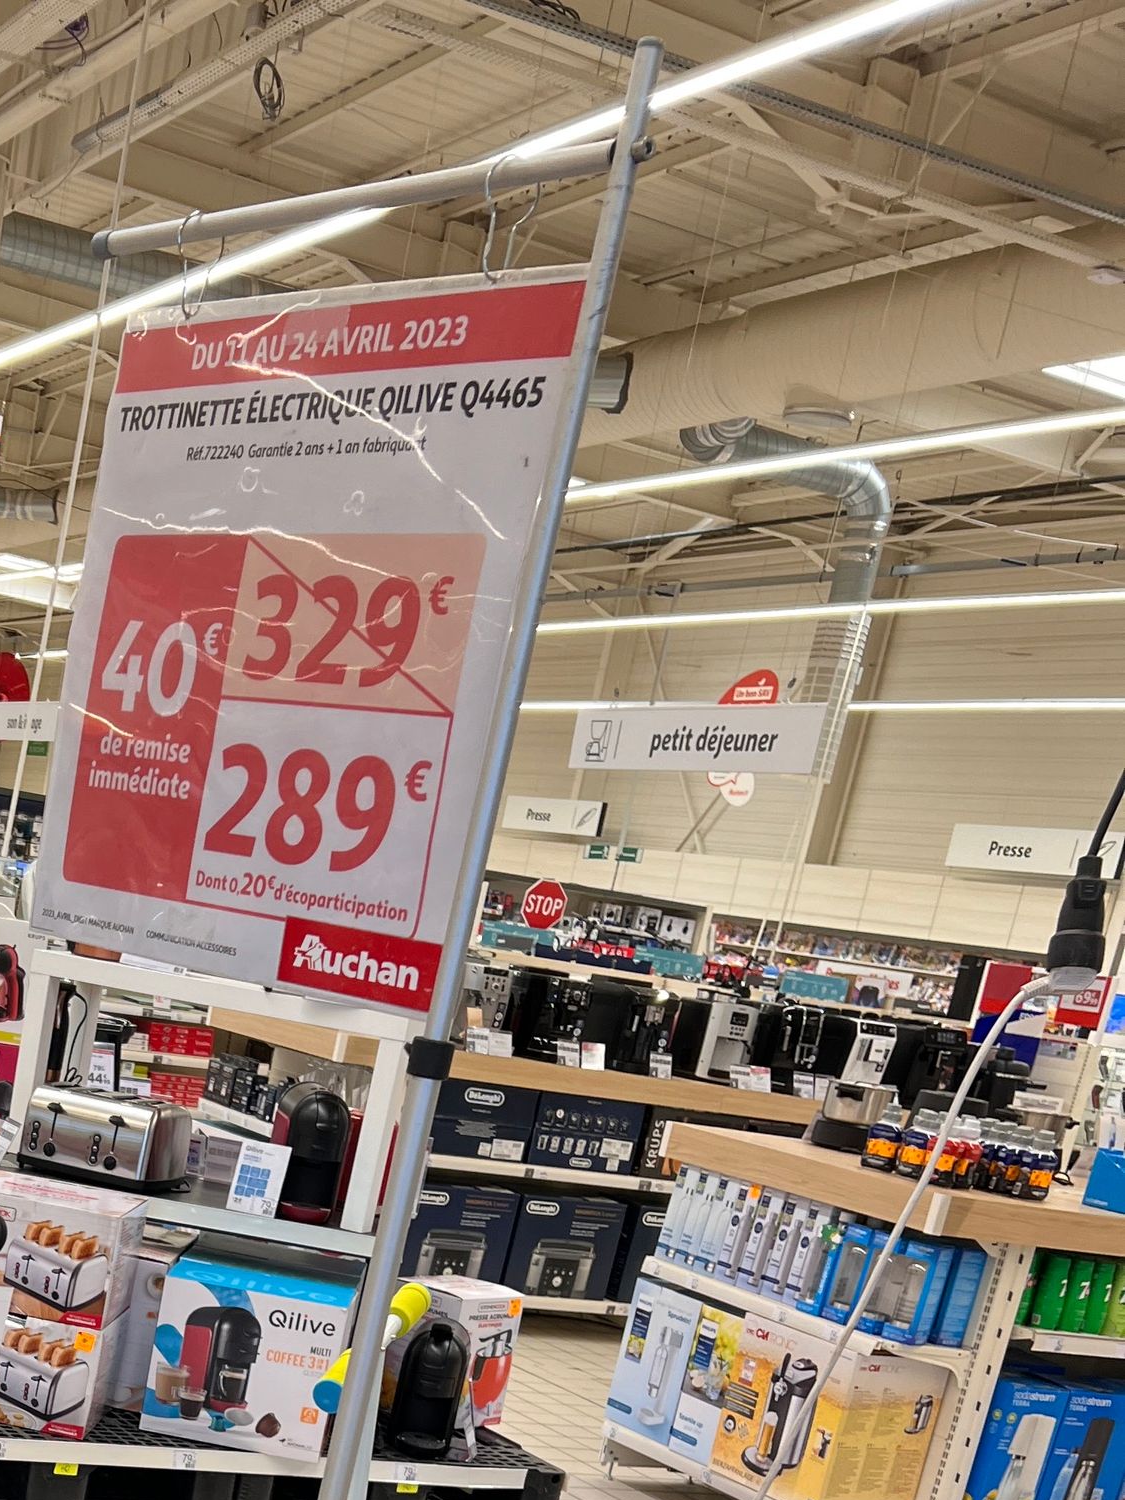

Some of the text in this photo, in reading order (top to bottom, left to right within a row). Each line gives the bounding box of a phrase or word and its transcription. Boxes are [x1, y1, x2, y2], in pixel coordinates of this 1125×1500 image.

[192, 342, 220, 371] DU
[251, 337, 283, 365] AU
[292, 332, 319, 361] 24
[323, 324, 394, 358] AVRIL
[399, 314, 469, 351] 2023
[120, 375, 546, 432] TROTTINETTE ÉLECTRIQUE QILIVE Q4465
[186, 443, 244, 461] Réf.722240
[248, 440, 293, 458] Garantie
[295, 440, 302, 457] 2
[304, 443, 324, 456] ans
[345, 442, 359, 454] an
[100, 732, 191, 765] de remise
[649, 725, 779, 760] petit déjeuner
[88, 760, 191, 800] immédiate
[526, 808, 551, 823] Presse
[988, 840, 1032, 858] Presse
[195, 869, 227, 893] Dont
[274, 882, 408, 923] d'écoparticipation
[525, 892, 563, 918] STOP
[293, 933, 420, 991] Auchan
[644, 1119, 665, 1169] KRUPS
[269, 1309, 336, 1337] Qilive
[266, 1349, 305, 1367] COFFEE
[309, 1346, 332, 1357] MULTI
